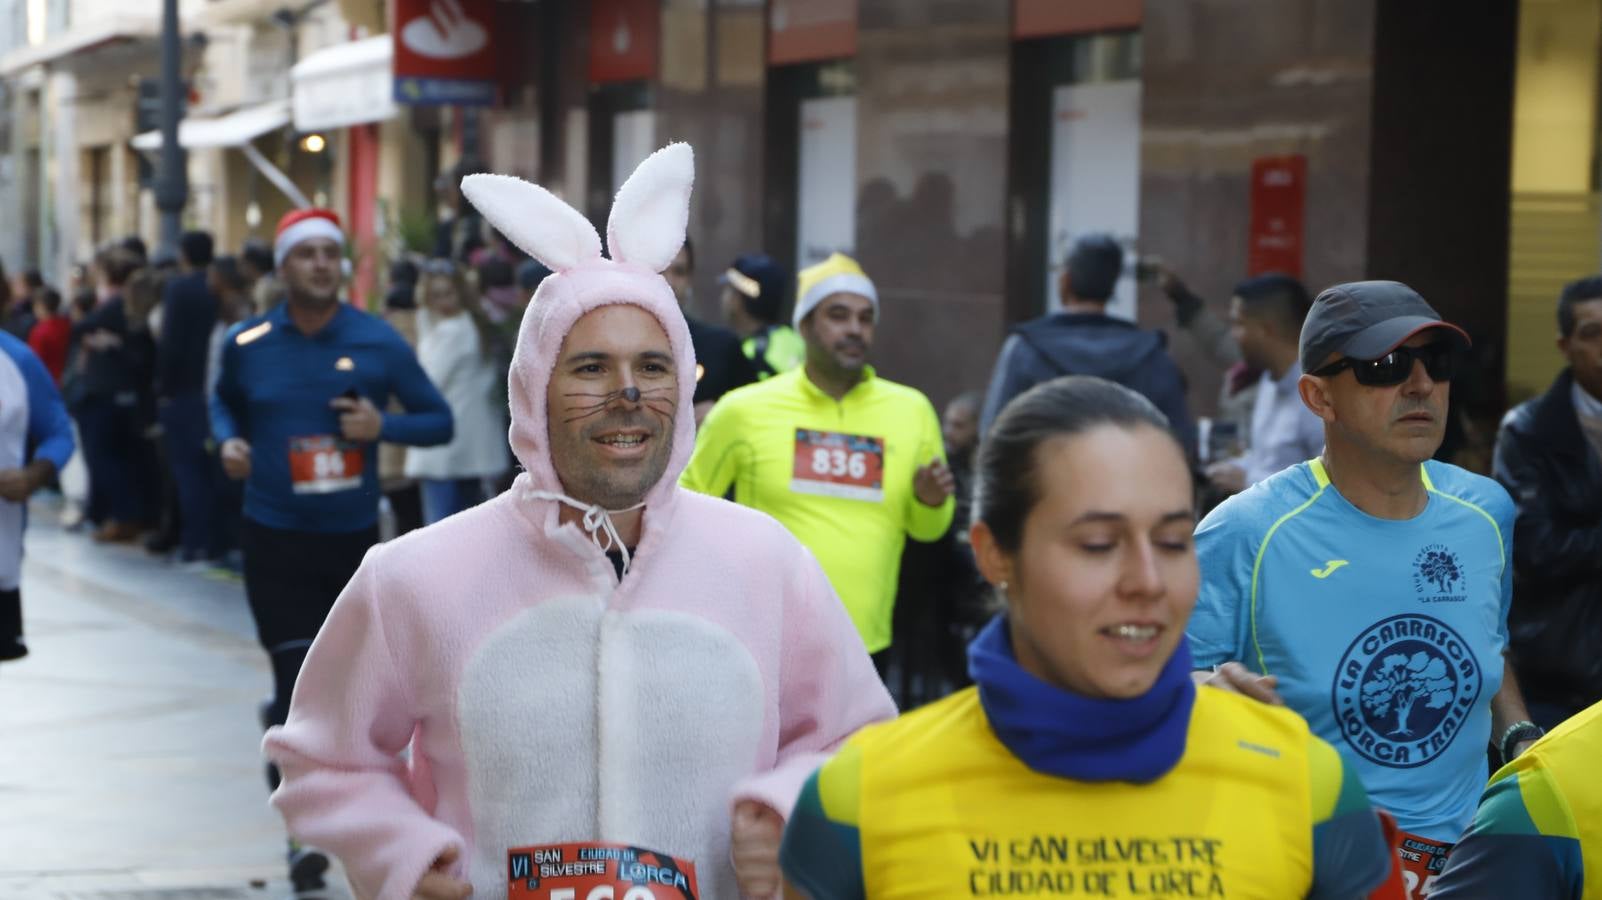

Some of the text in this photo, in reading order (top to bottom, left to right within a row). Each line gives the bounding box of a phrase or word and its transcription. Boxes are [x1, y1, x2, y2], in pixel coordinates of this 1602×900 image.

[812, 448, 866, 479] 836
[1340, 619, 1475, 690] LA CARRASCA
[1342, 707, 1410, 763] LORCA
[1416, 696, 1473, 759] TRAIL
[534, 848, 562, 864] SAN
[580, 847, 620, 861] CIUDAD
[969, 835, 1224, 868] VI SAN SILVESTRE
[512, 854, 528, 879] VI
[540, 861, 606, 878] SILVESTRE
[620, 861, 688, 890] LORCA
[968, 869, 1225, 898] CIUDAD DE LORCA
